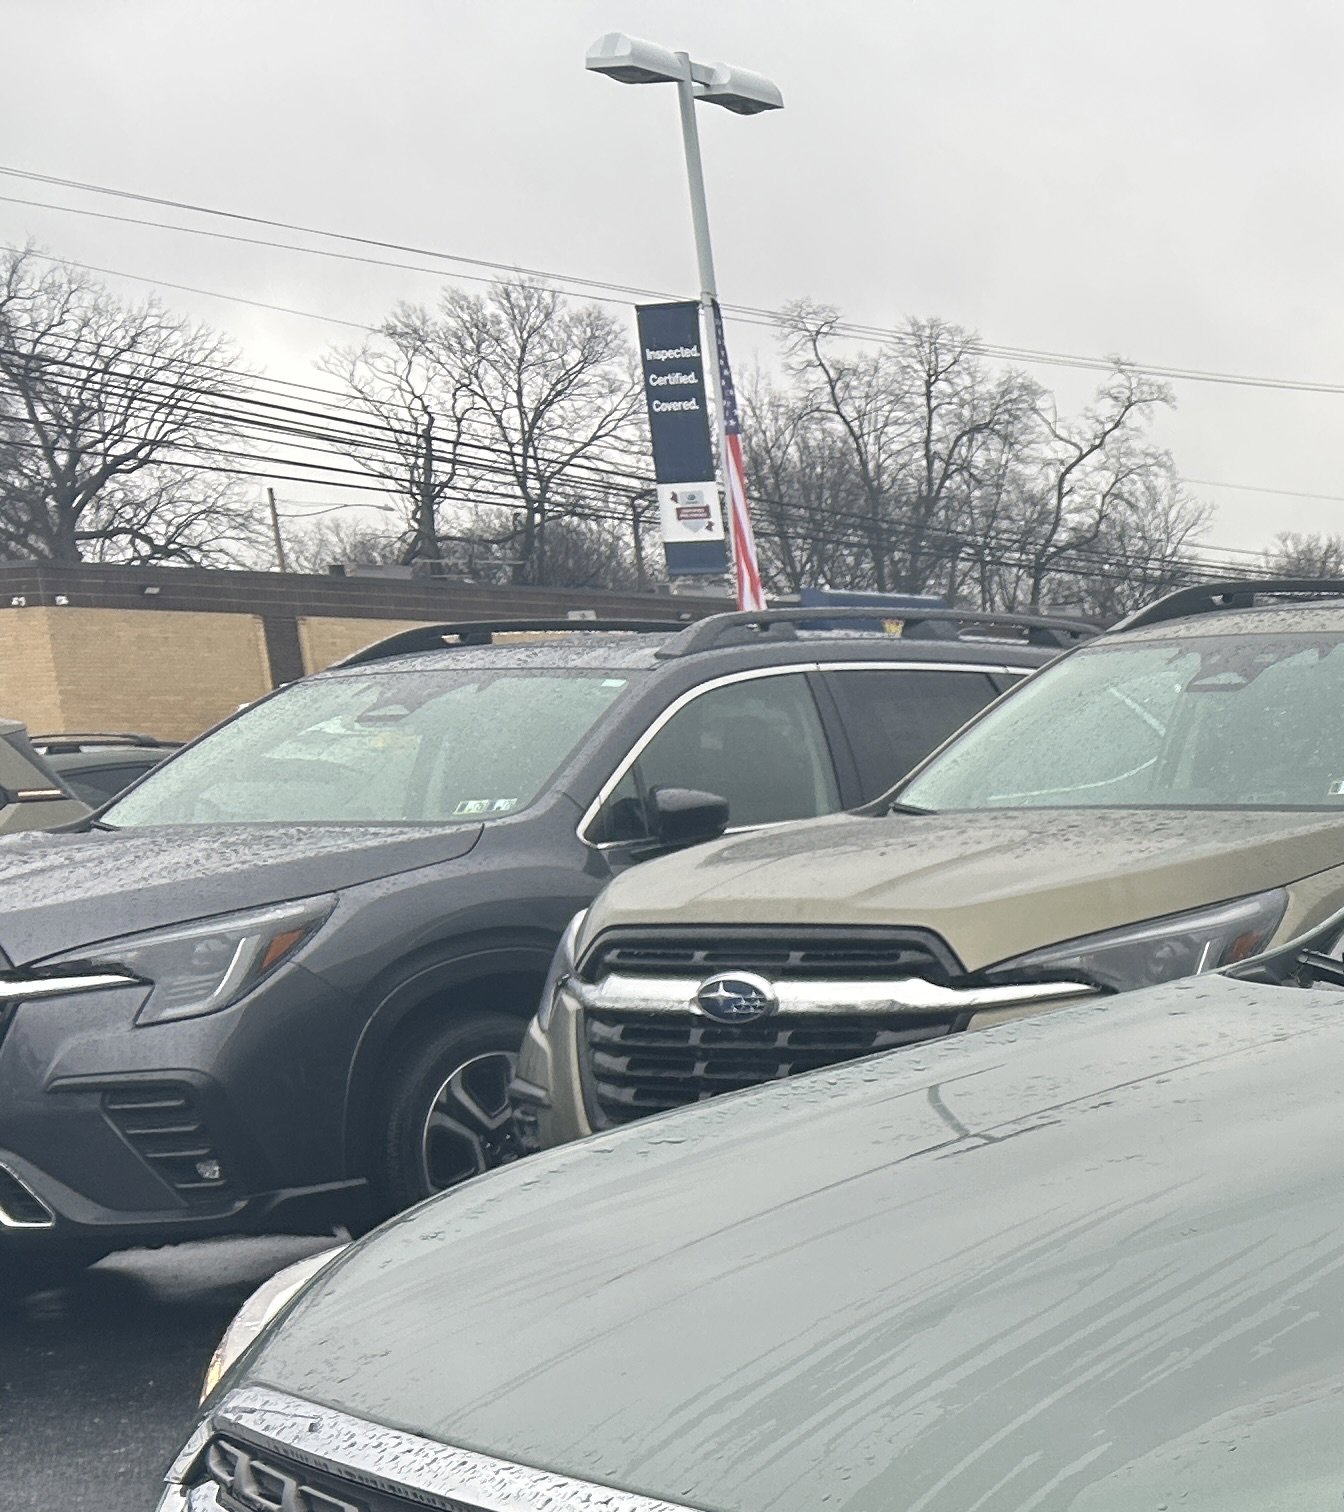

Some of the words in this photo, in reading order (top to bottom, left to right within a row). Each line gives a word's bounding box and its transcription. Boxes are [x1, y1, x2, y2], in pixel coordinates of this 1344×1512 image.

[646, 345, 700, 361] Inspected.
[649, 372, 698, 386] Certified.
[653, 398, 699, 412] Covered.
